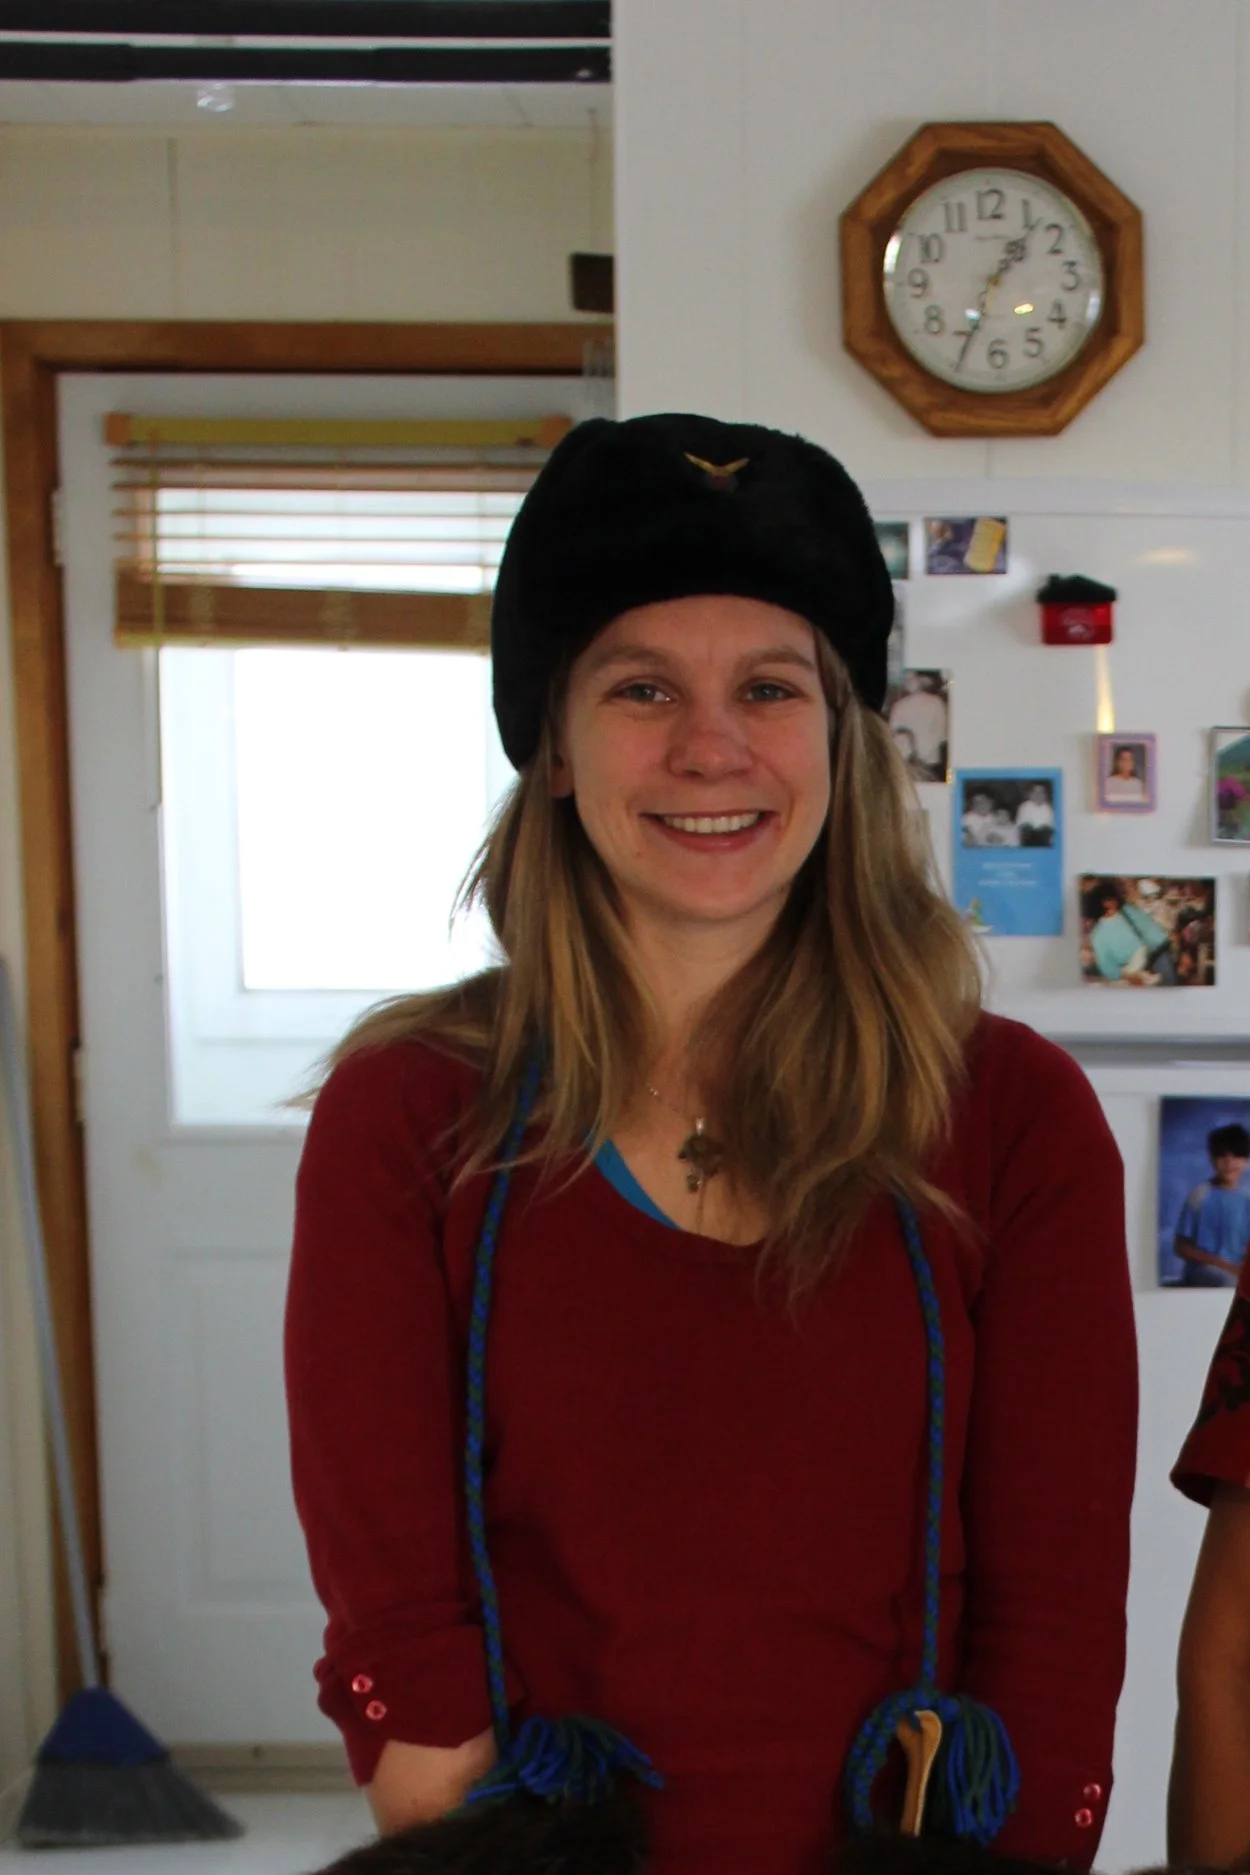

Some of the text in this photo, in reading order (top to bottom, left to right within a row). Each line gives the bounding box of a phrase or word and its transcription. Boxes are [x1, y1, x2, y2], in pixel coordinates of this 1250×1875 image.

[945, 201, 968, 233] 11
[976, 189, 1004, 220] 12
[1022, 199, 1036, 230] 1
[919, 234, 944, 264] 10
[1046, 224, 1063, 255] 2
[909, 268, 929, 298] 9
[1062, 261, 1080, 291] 3
[924, 305, 943, 334] 8
[1048, 300, 1067, 329] 4
[953, 330, 973, 365] 7
[988, 339, 1009, 370] 6
[1026, 328, 1044, 358] 5
